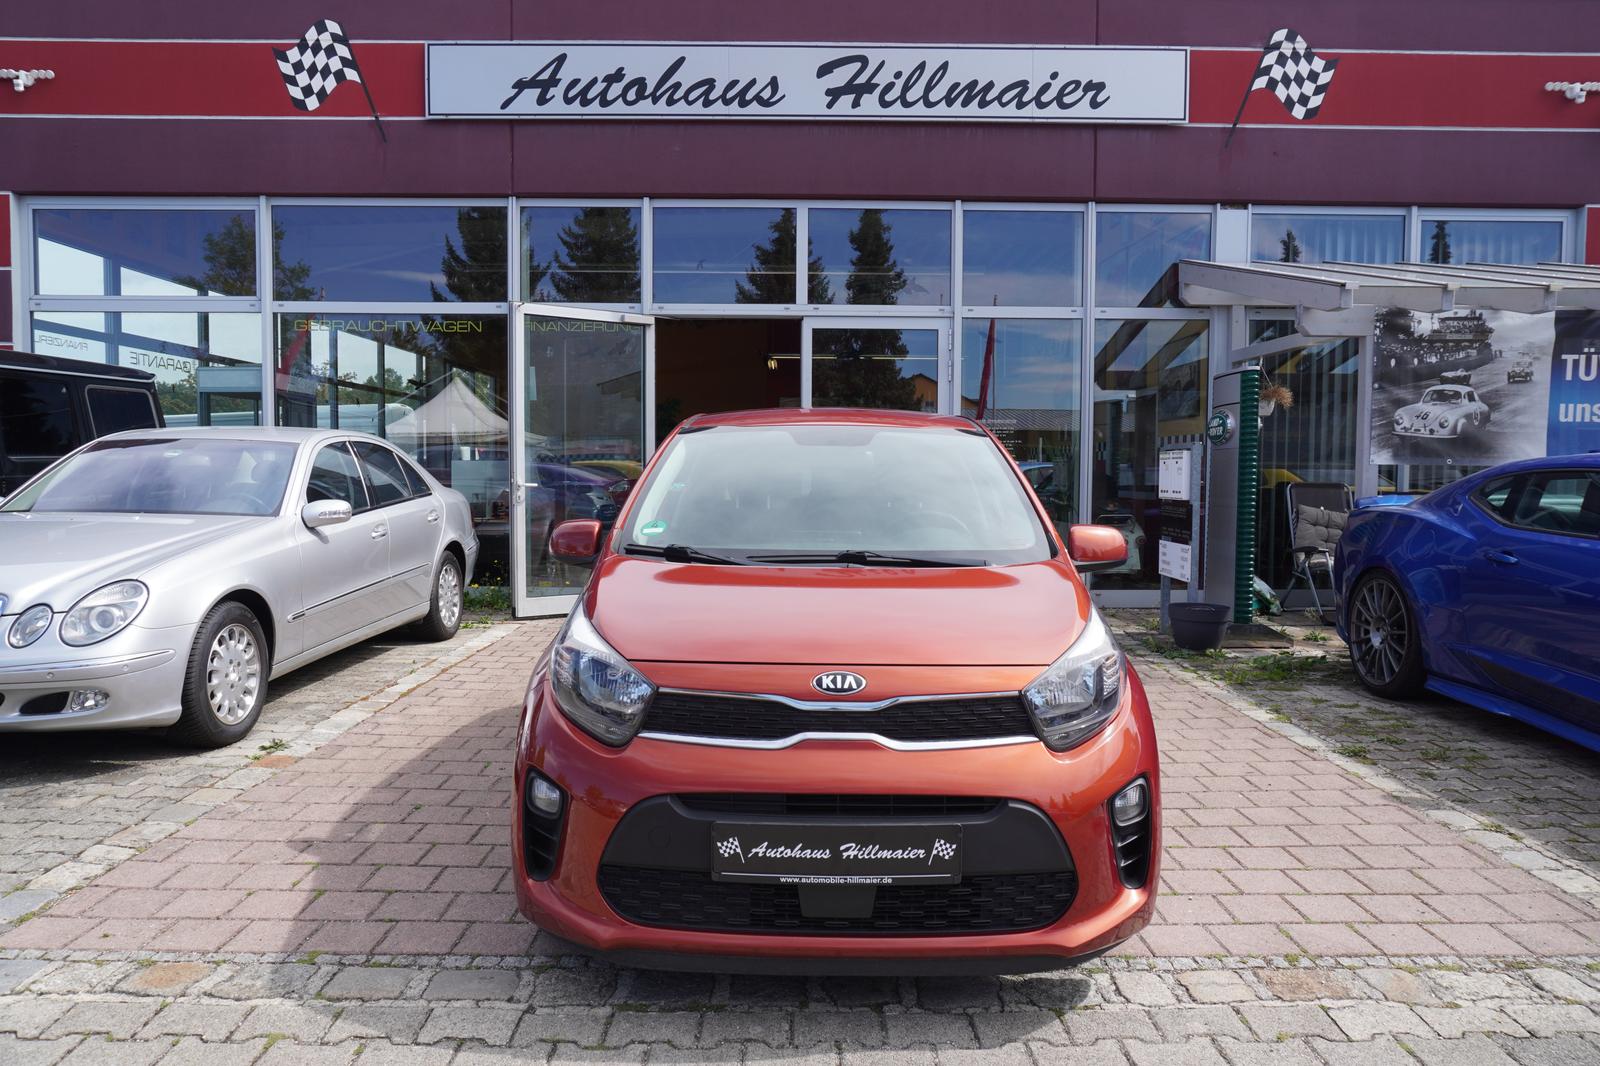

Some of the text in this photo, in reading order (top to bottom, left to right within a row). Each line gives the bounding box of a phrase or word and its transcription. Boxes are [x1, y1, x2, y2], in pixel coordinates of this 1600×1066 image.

[500, 52, 1110, 110] Autohaus Hillmaier
[294, 320, 482, 333] GEBRAUCHTWAGEN
[1561, 348, 1600, 381] TÜ
[822, 675, 857, 689] KIA
[748, 841, 926, 860] Autohaus Hillmaier
[779, 876, 893, 885] www.automobile-hillmaier.de
